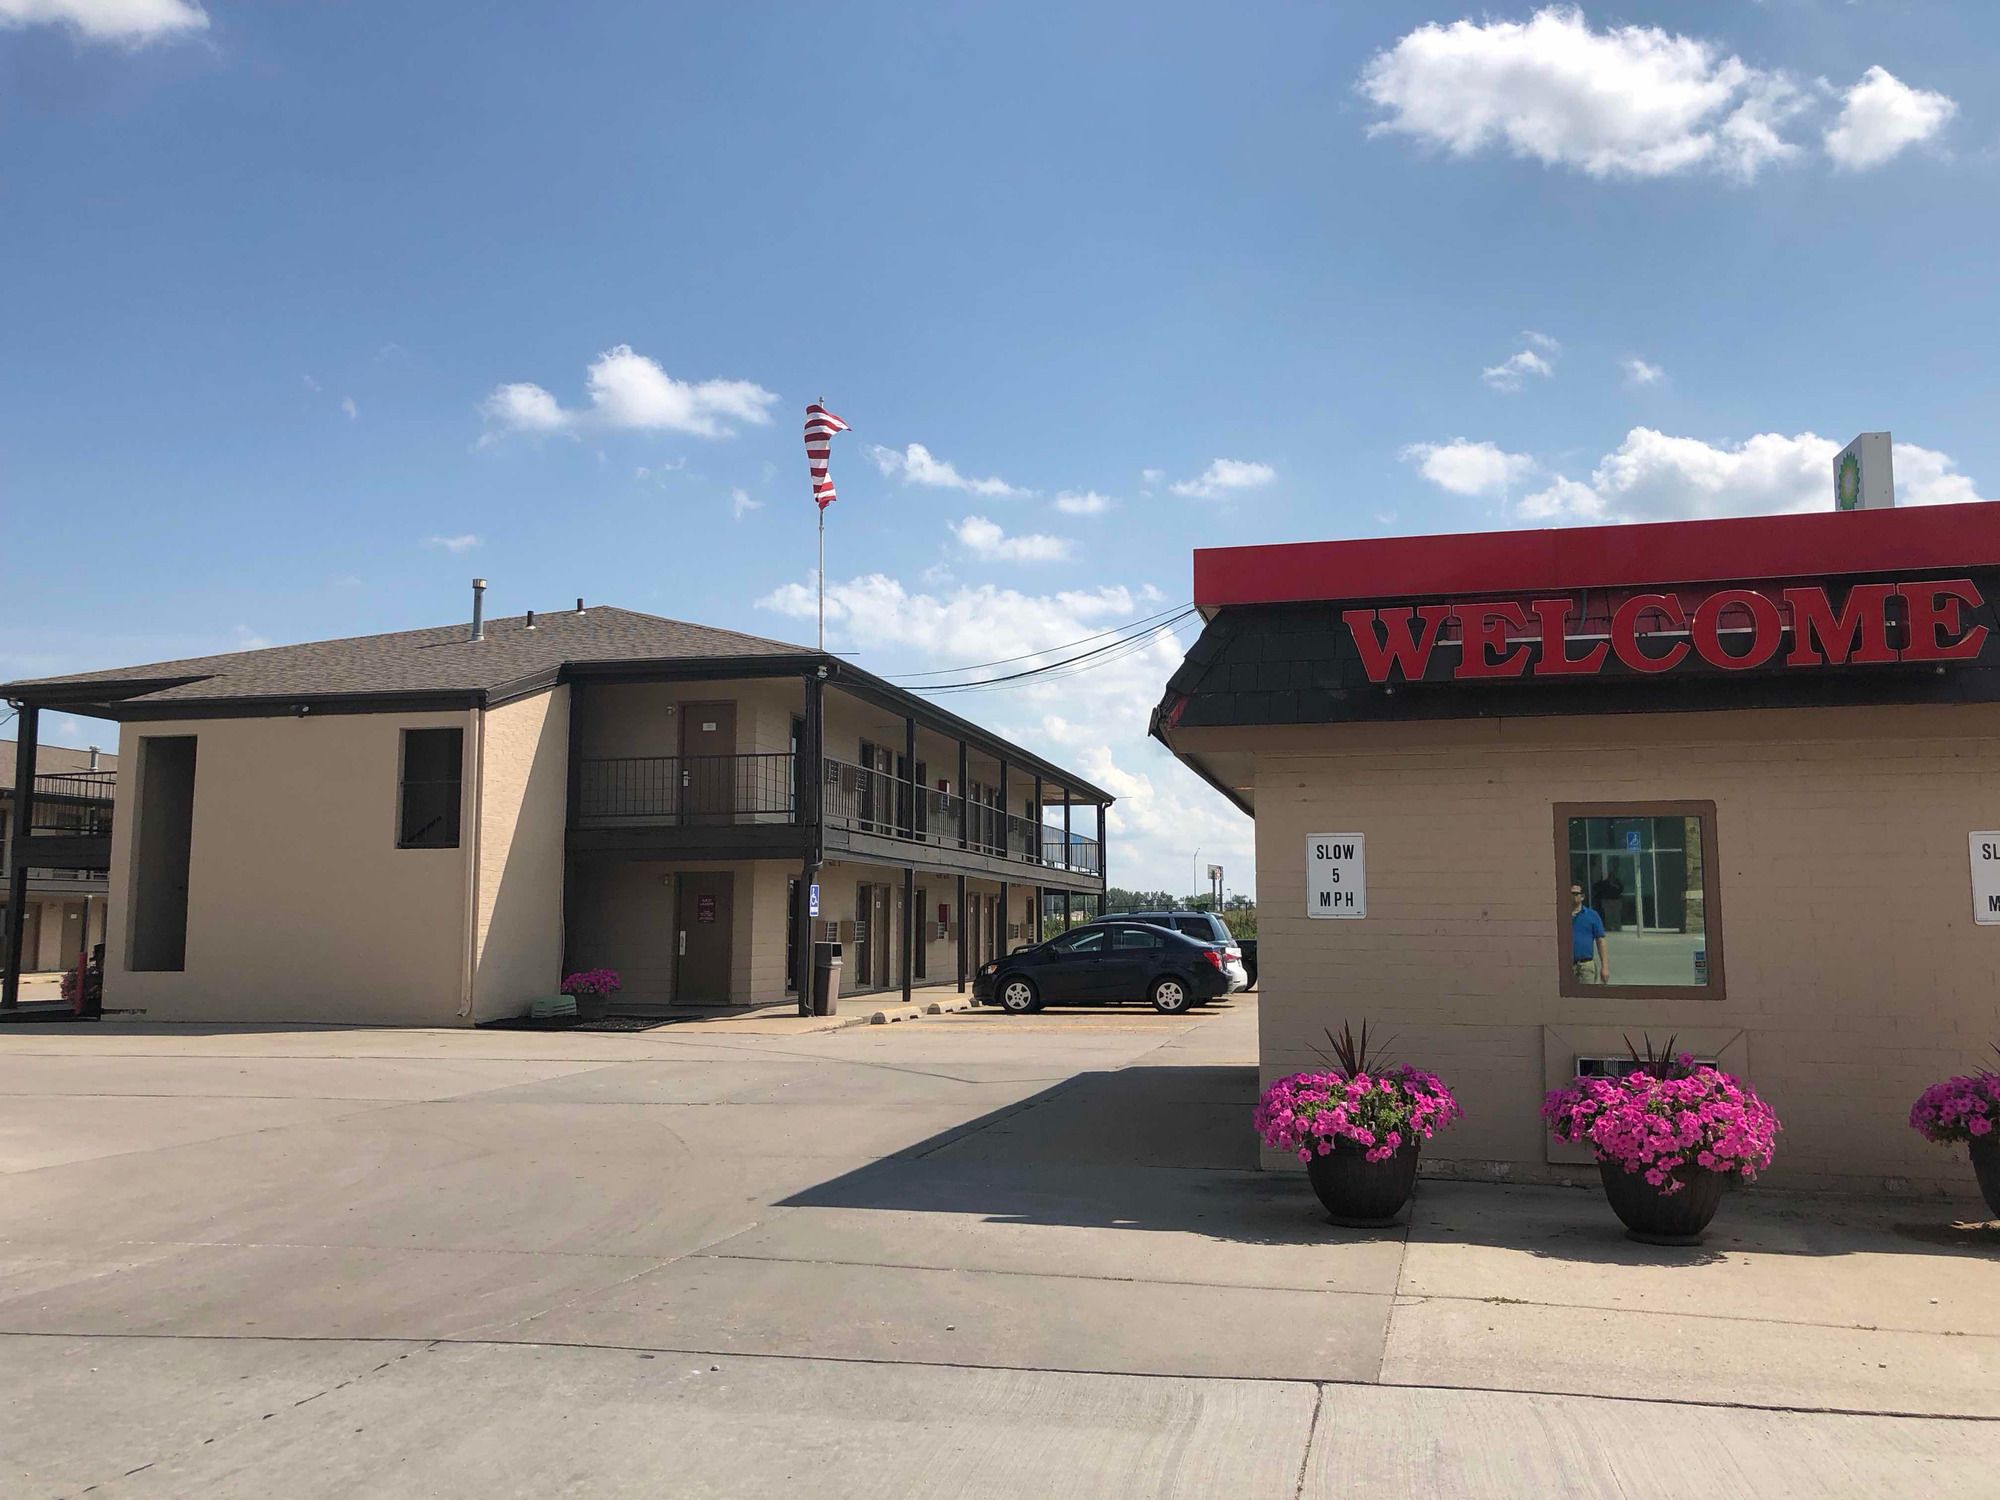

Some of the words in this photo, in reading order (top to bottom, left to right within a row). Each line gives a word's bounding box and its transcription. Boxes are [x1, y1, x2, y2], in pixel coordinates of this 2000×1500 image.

[1342, 579, 1989, 682] WELCOME
[1316, 844, 1354, 860] SLOW
[1332, 868, 1340, 883] 5
[1320, 891, 1354, 907] MPH
